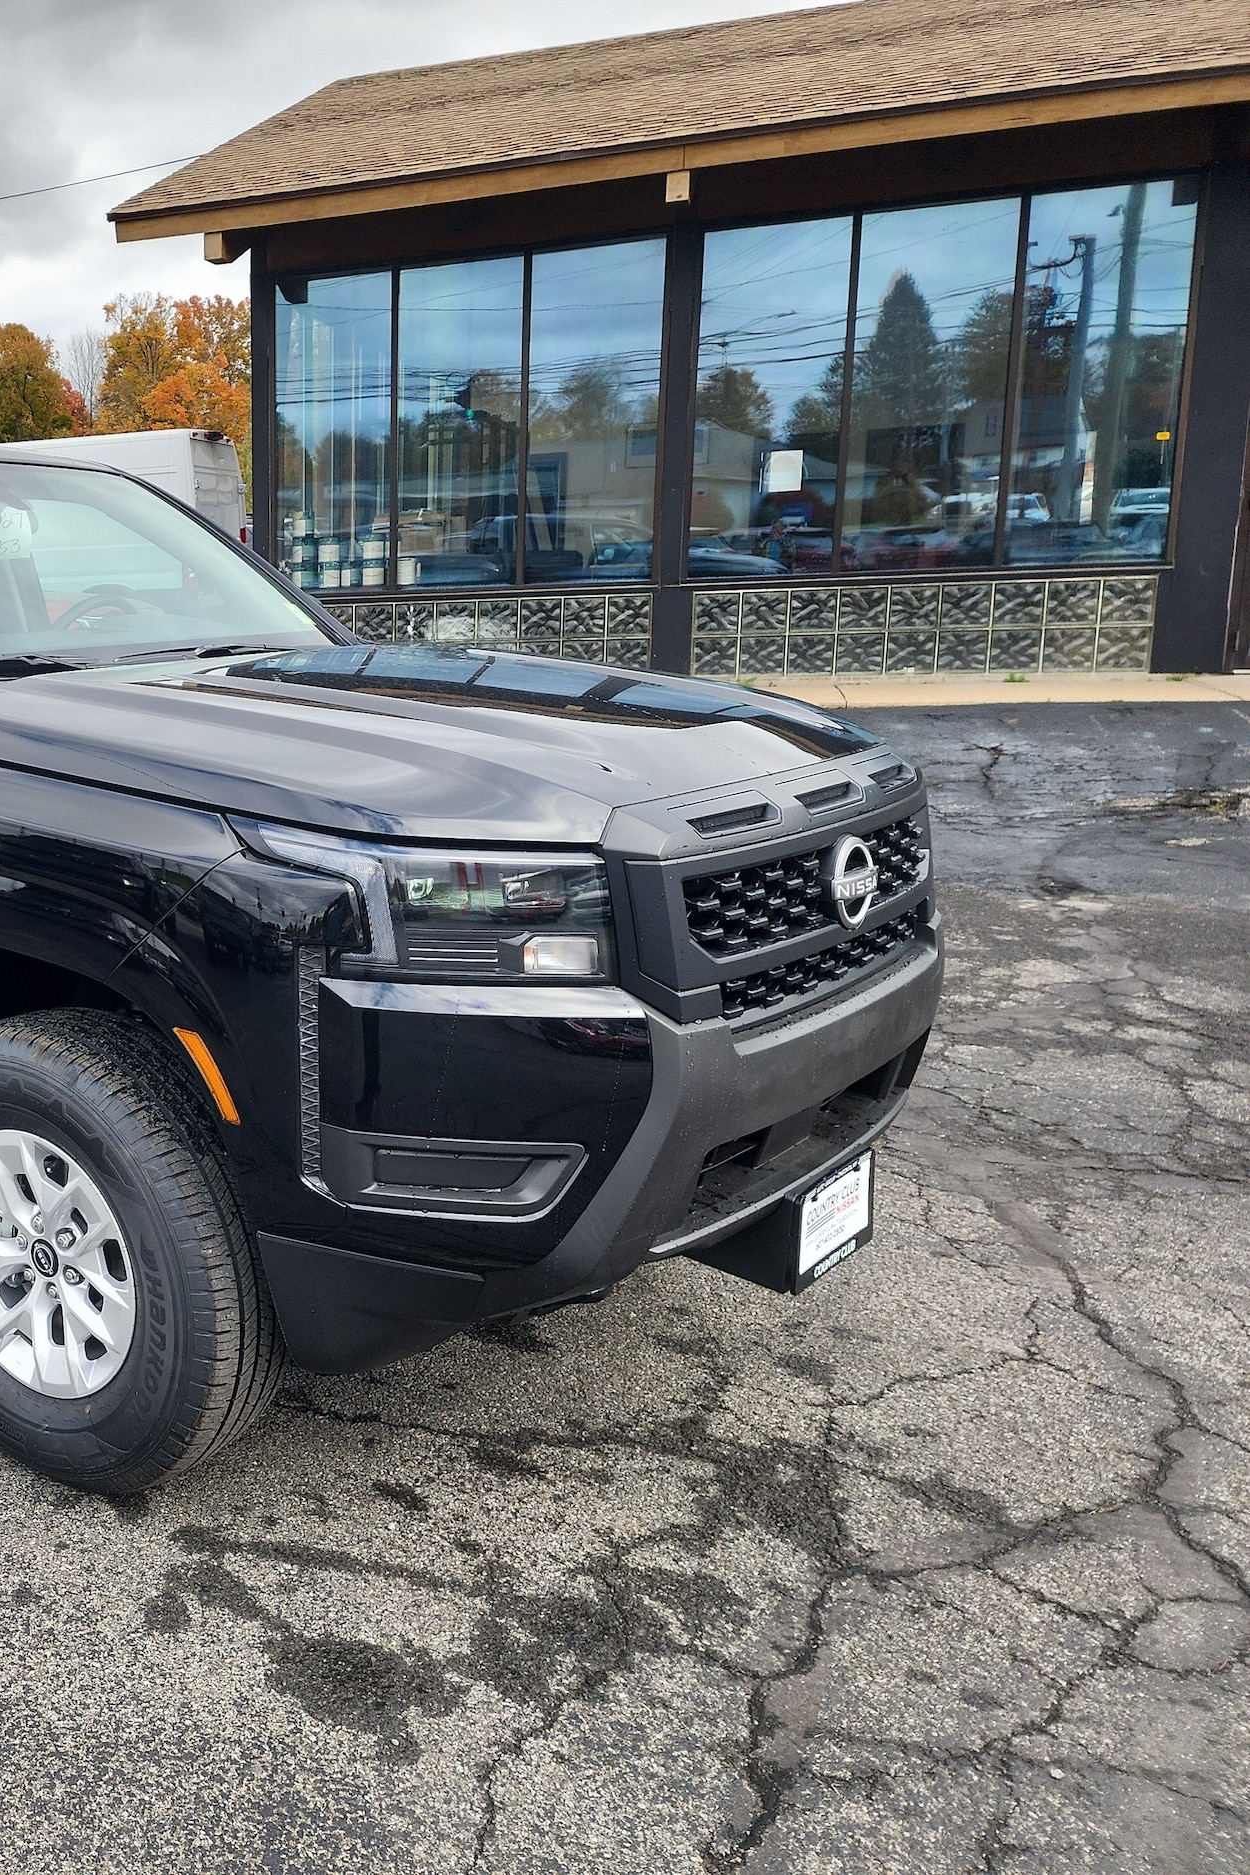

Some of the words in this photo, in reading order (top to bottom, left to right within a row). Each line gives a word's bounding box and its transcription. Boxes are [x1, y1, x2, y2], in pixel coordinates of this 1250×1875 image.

[807, 1189, 842, 1225] COUNTRY
[841, 1178, 860, 1201] CLUB
[836, 1194, 860, 1214] NISSAN
[813, 1246, 841, 1279] COUNTRY
[840, 1239, 857, 1259] CLUB
